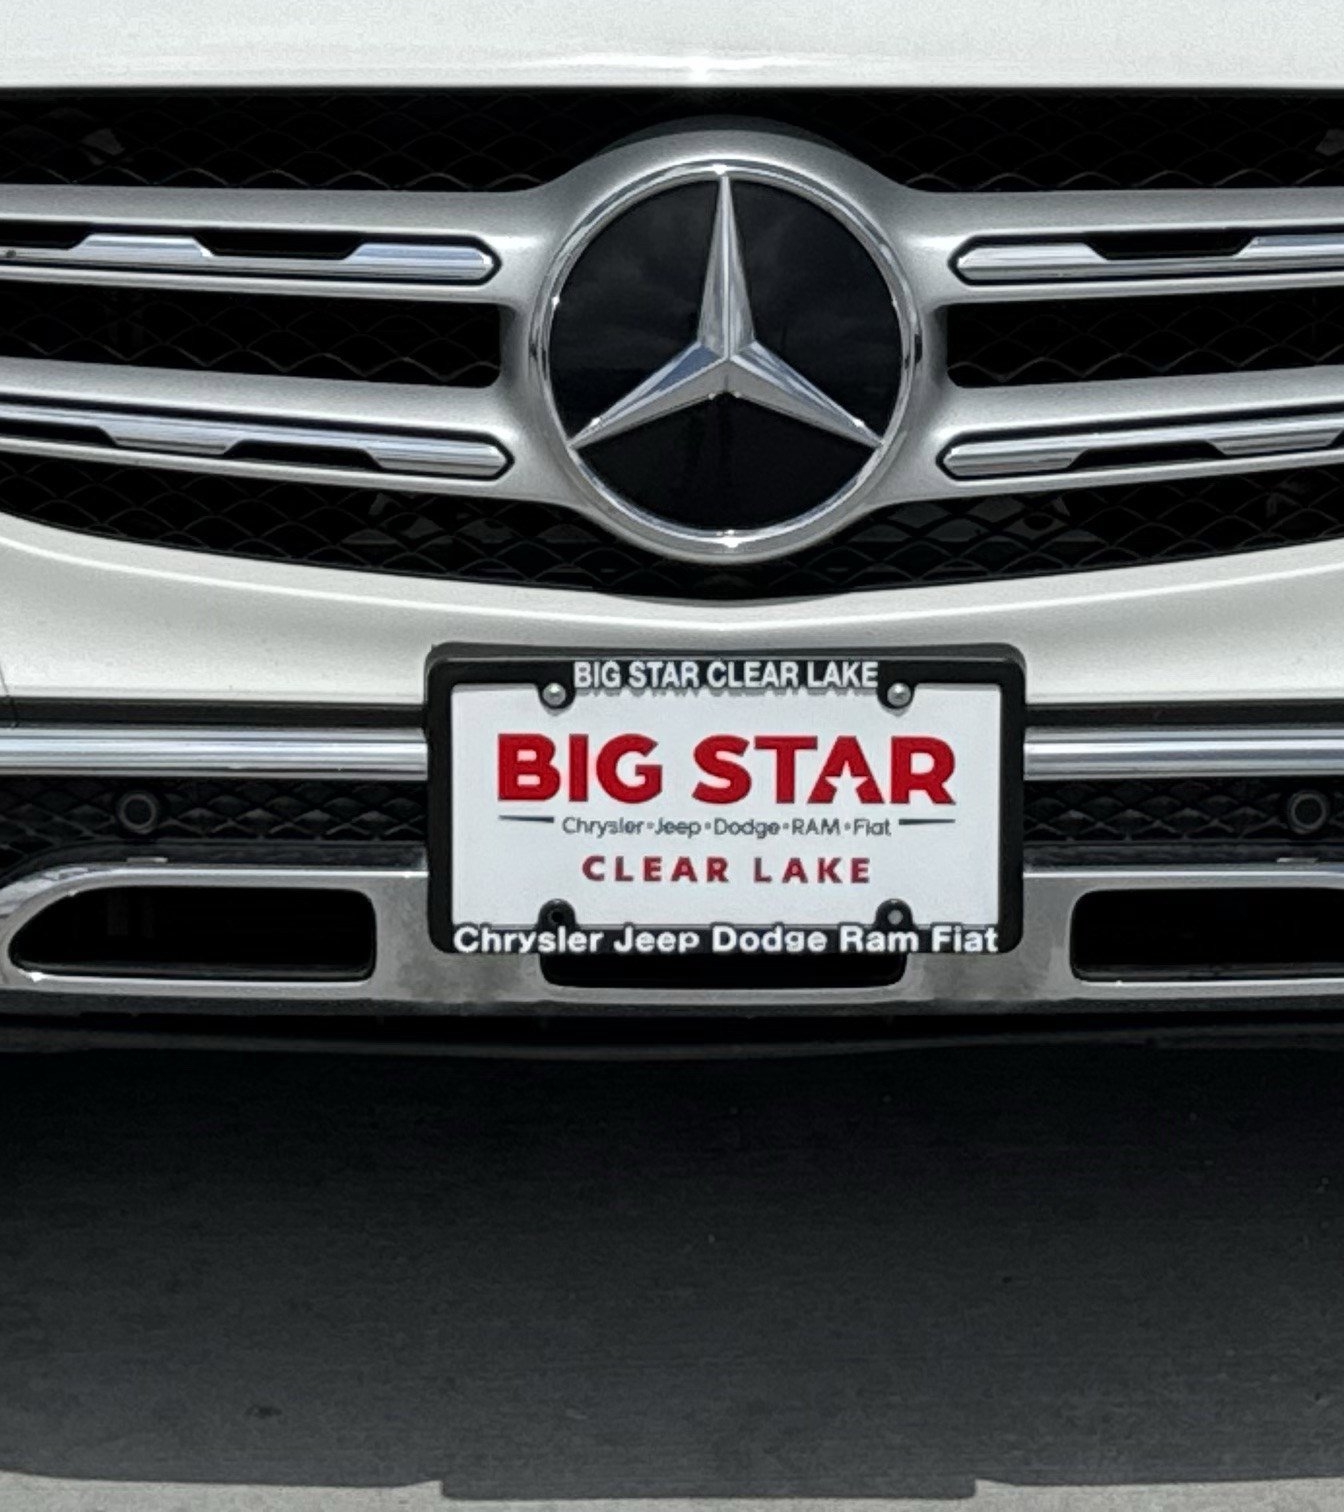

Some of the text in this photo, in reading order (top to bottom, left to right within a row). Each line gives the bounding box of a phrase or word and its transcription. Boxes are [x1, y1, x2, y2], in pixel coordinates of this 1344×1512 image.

[574, 661, 878, 688] BIG STAR CLEAR LAKE
[498, 733, 956, 805] BIG STAR
[582, 855, 870, 883] CLEAR LAKE
[453, 925, 999, 953] Chrysler Jeep Dodge Ram Fiat
